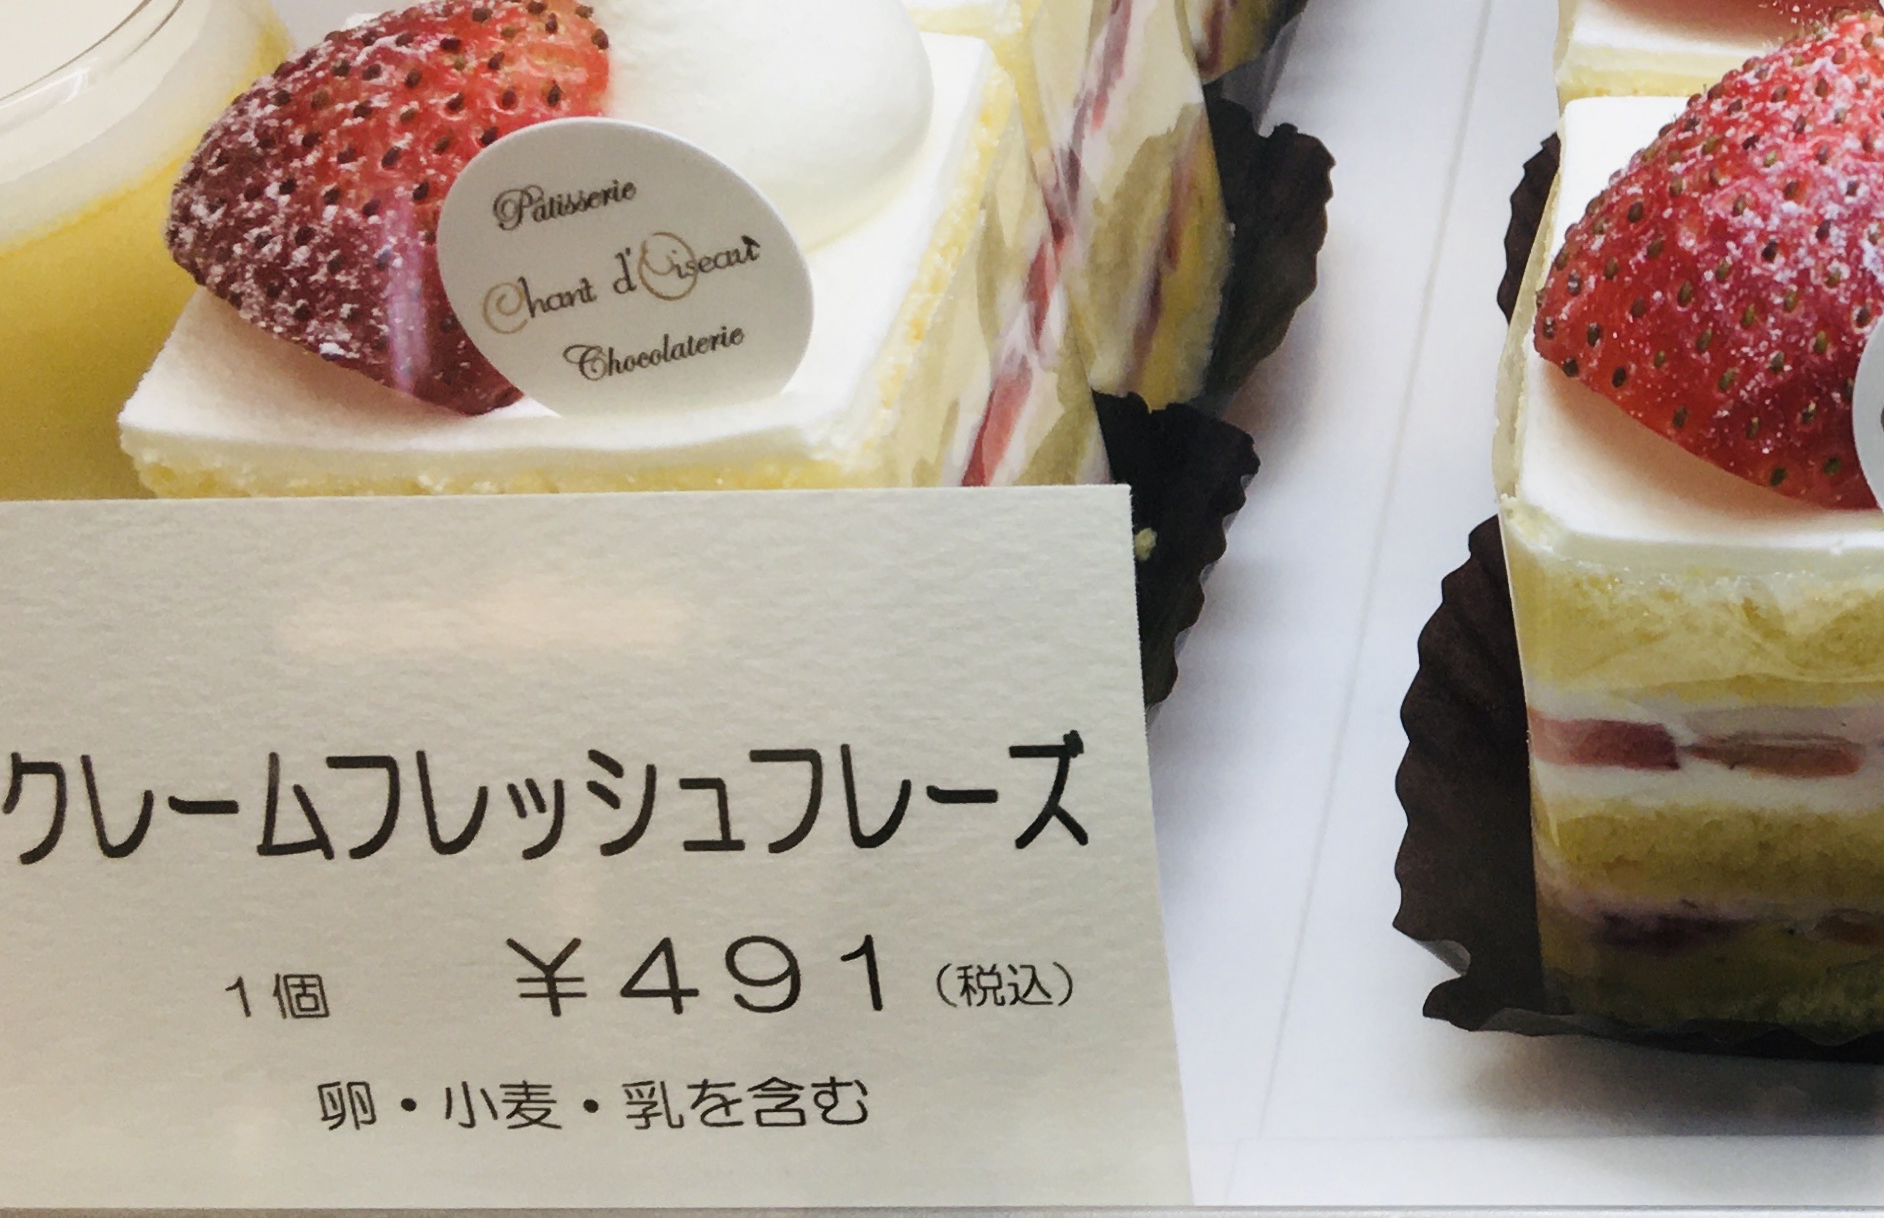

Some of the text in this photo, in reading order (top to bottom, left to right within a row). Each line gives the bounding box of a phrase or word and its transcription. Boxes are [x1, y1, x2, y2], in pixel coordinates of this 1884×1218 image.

[493, 179, 636, 230] Pâtisserie
[482, 276, 597, 334] Chant
[562, 325, 745, 381] Chocolaterie
[1, 729, 1089, 865] クレームフレッシュフレーズ
[225, 973, 330, 1020] 1個
[506, 934, 886, 1018] ¥491
